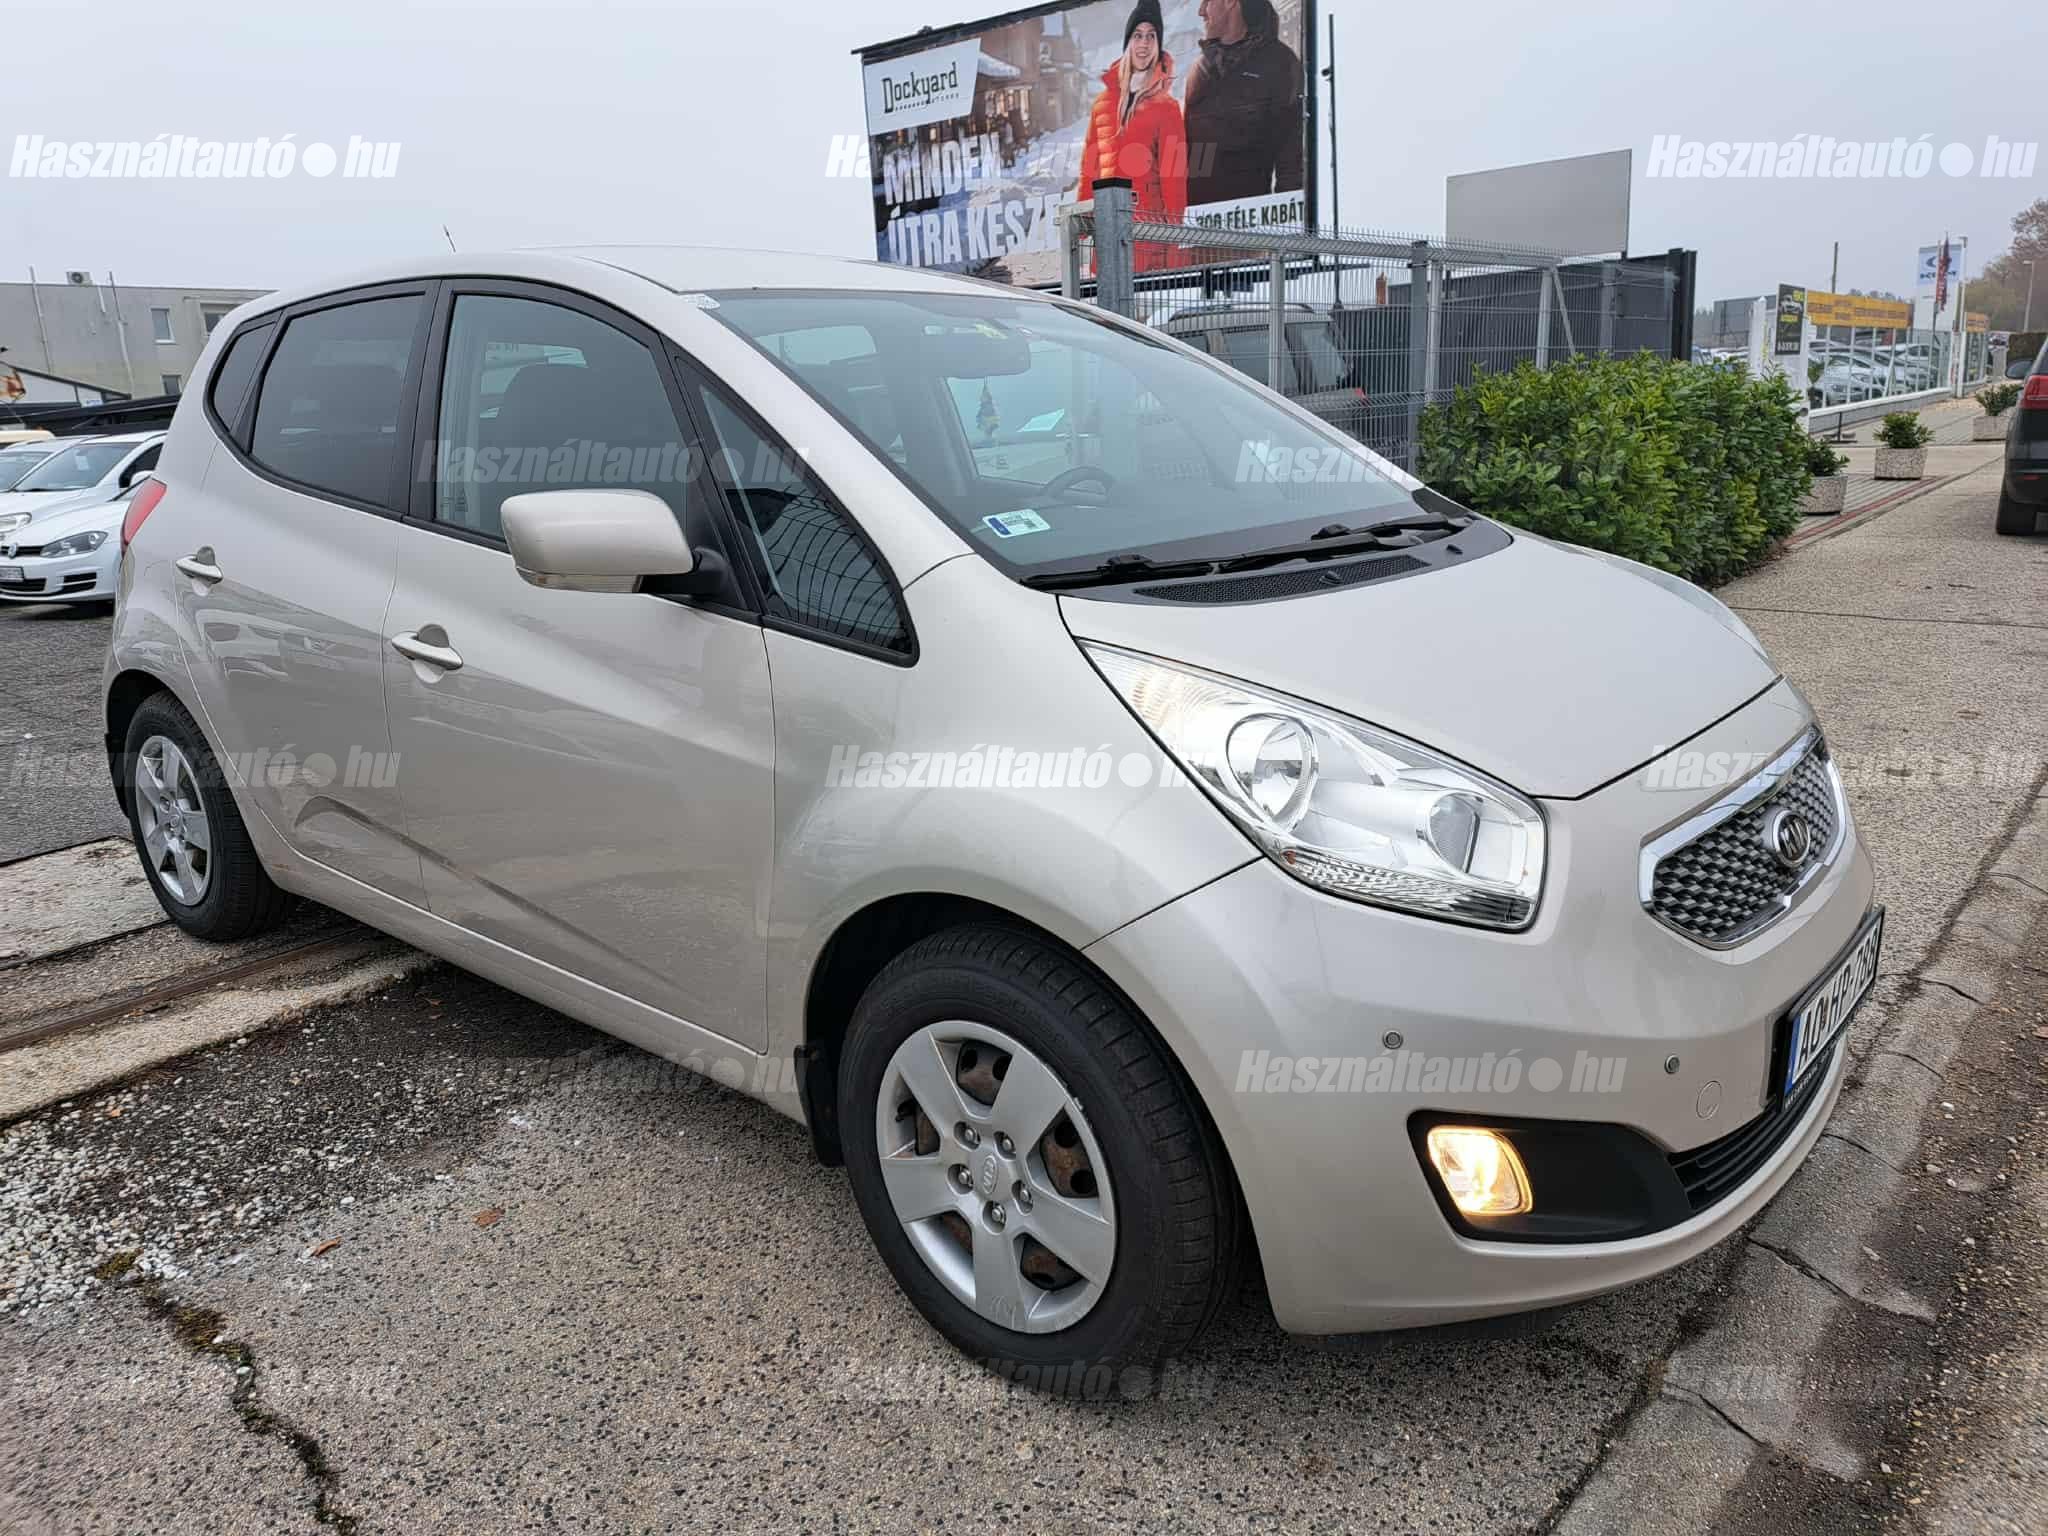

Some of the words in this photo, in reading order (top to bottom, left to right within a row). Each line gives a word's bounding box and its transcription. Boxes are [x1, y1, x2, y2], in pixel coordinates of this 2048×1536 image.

[882, 62, 958, 114] Dockyard
[883, 132, 1001, 206] MINDEN
[887, 204, 963, 267] ÚTRA
[967, 191, 1076, 261] KÉSZE
[1260, 197, 1305, 226] KABÁT
